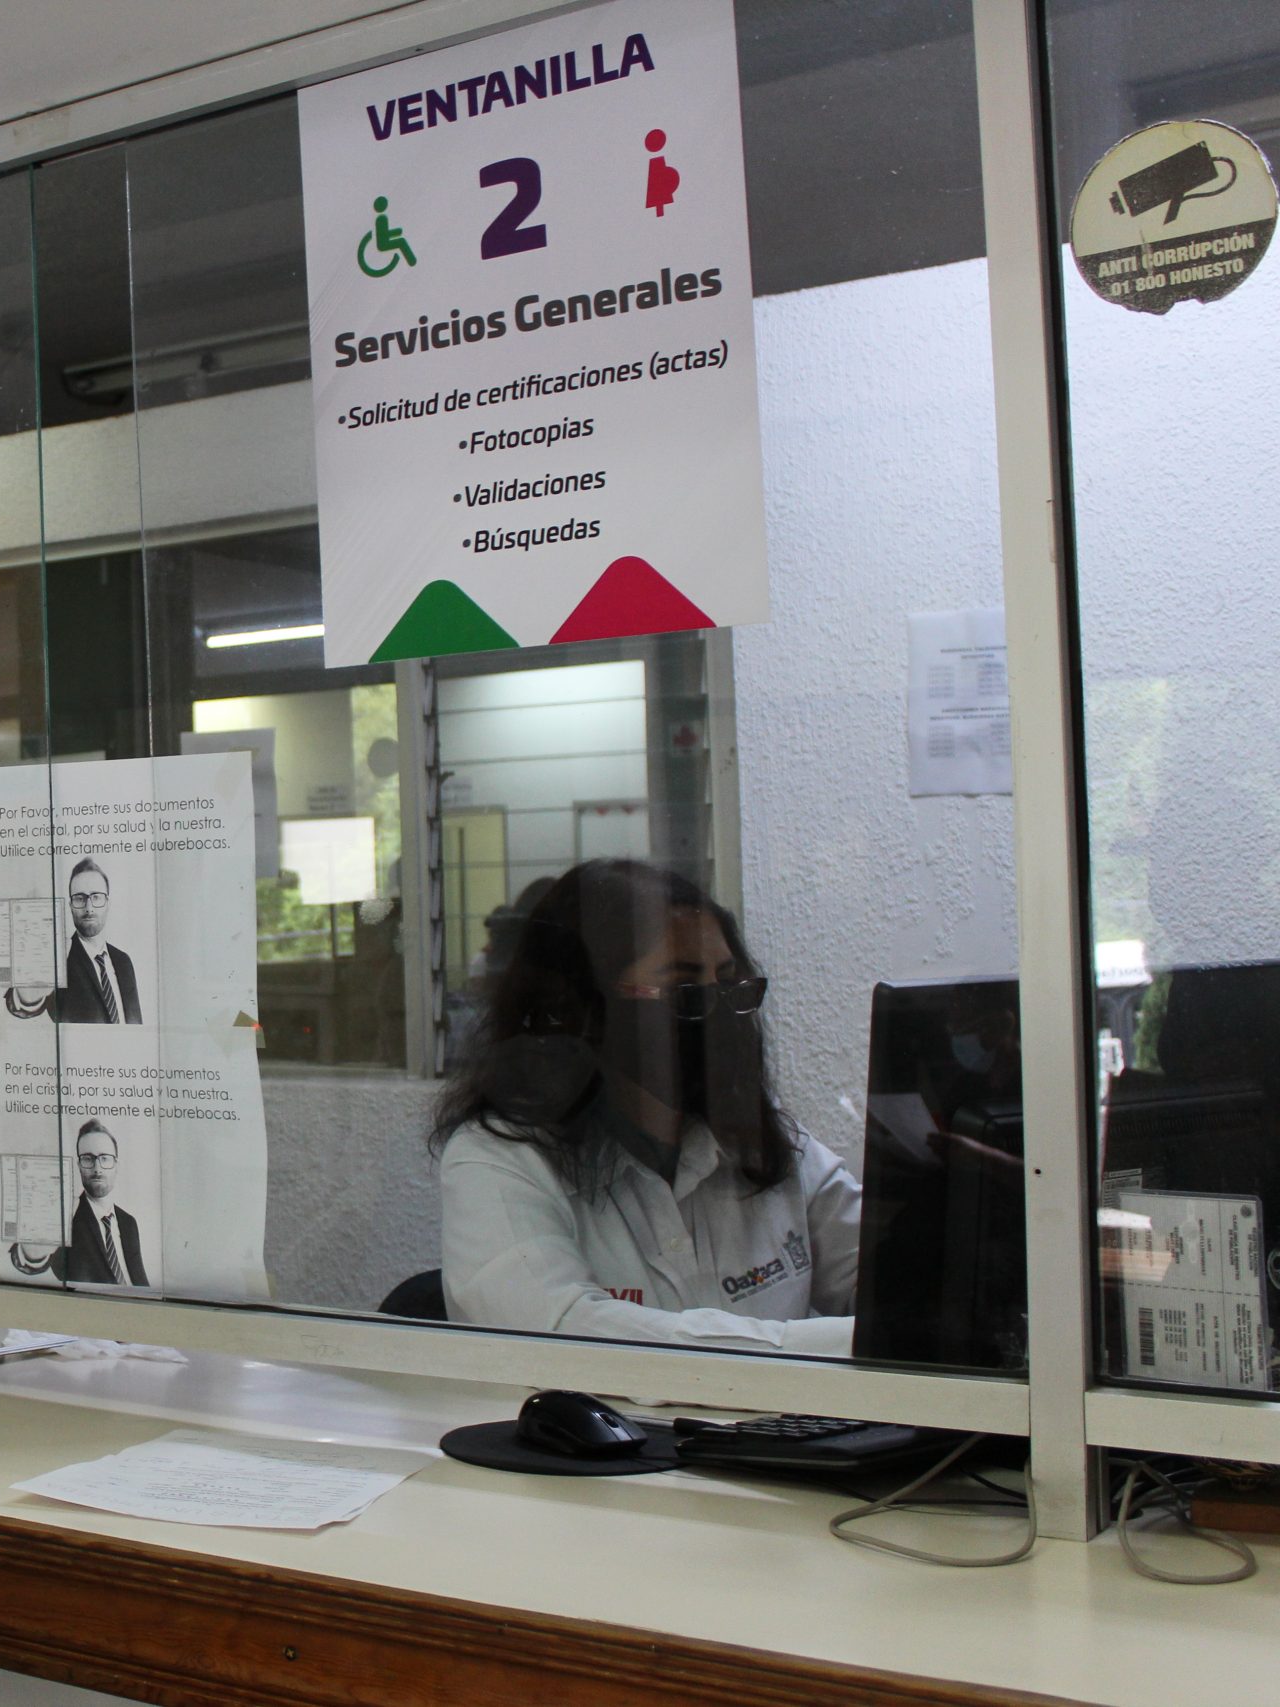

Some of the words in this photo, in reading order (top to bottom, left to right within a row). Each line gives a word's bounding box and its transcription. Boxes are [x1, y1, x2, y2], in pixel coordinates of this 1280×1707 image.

[366, 33, 655, 141] VENTANILLA
[479, 157, 547, 260] 2
[1098, 256, 1137, 278] ANTI
[1142, 232, 1255, 269] CORRUPCIÓN
[1111, 281, 1130, 297] 01
[1135, 273, 1166, 292] 800
[1169, 258, 1244, 286] HONESTO
[335, 308, 507, 368] Servicios
[514, 267, 723, 331] Generales
[348, 391, 439, 429] Solicitud
[443, 388, 471, 413] de
[476, 358, 643, 407] certificaciones
[648, 340, 728, 380] (actas)
[469, 416, 595, 454] Fotocopias
[464, 468, 606, 508] Validaciones
[474, 518, 601, 553] Búsquedas
[0, 807, 18, 820] Por
[21, 805, 59, 819] Favor,
[62, 804, 111, 817] muestre
[113, 801, 132, 815] sus
[134, 797, 215, 814] documentos
[0, 827, 15, 839] en
[18, 825, 29, 838] el
[31, 823, 70, 838] cristal,
[73, 824, 95, 838] por
[97, 823, 111, 836] su
[113, 820, 147, 833] salud
[158, 819, 171, 832] la
[174, 816, 226, 831] nuestra.
[0, 844, 35, 858] Utilice
[38, 840, 133, 857] correctamente
[136, 839, 148, 853] el
[5, 1063, 22, 1076] Por
[66, 1065, 115, 1079] muestre
[118, 1067, 137, 1080] sus
[140, 1066, 221, 1082] documentos
[5, 1083, 20, 1095] en
[22, 1082, 33, 1095] el
[36, 1083, 75, 1098] cristal,
[78, 1085, 99, 1100] por
[102, 1086, 116, 1098] su
[119, 1085, 154, 1099] salud
[166, 1086, 179, 1100] la
[182, 1087, 233, 1102] nuestra.
[5, 1101, 40, 1115] Utilice
[43, 1103, 140, 1119] correctamente
[143, 1105, 155, 1118] el
[158, 1106, 241, 1122] cubrebocas.
